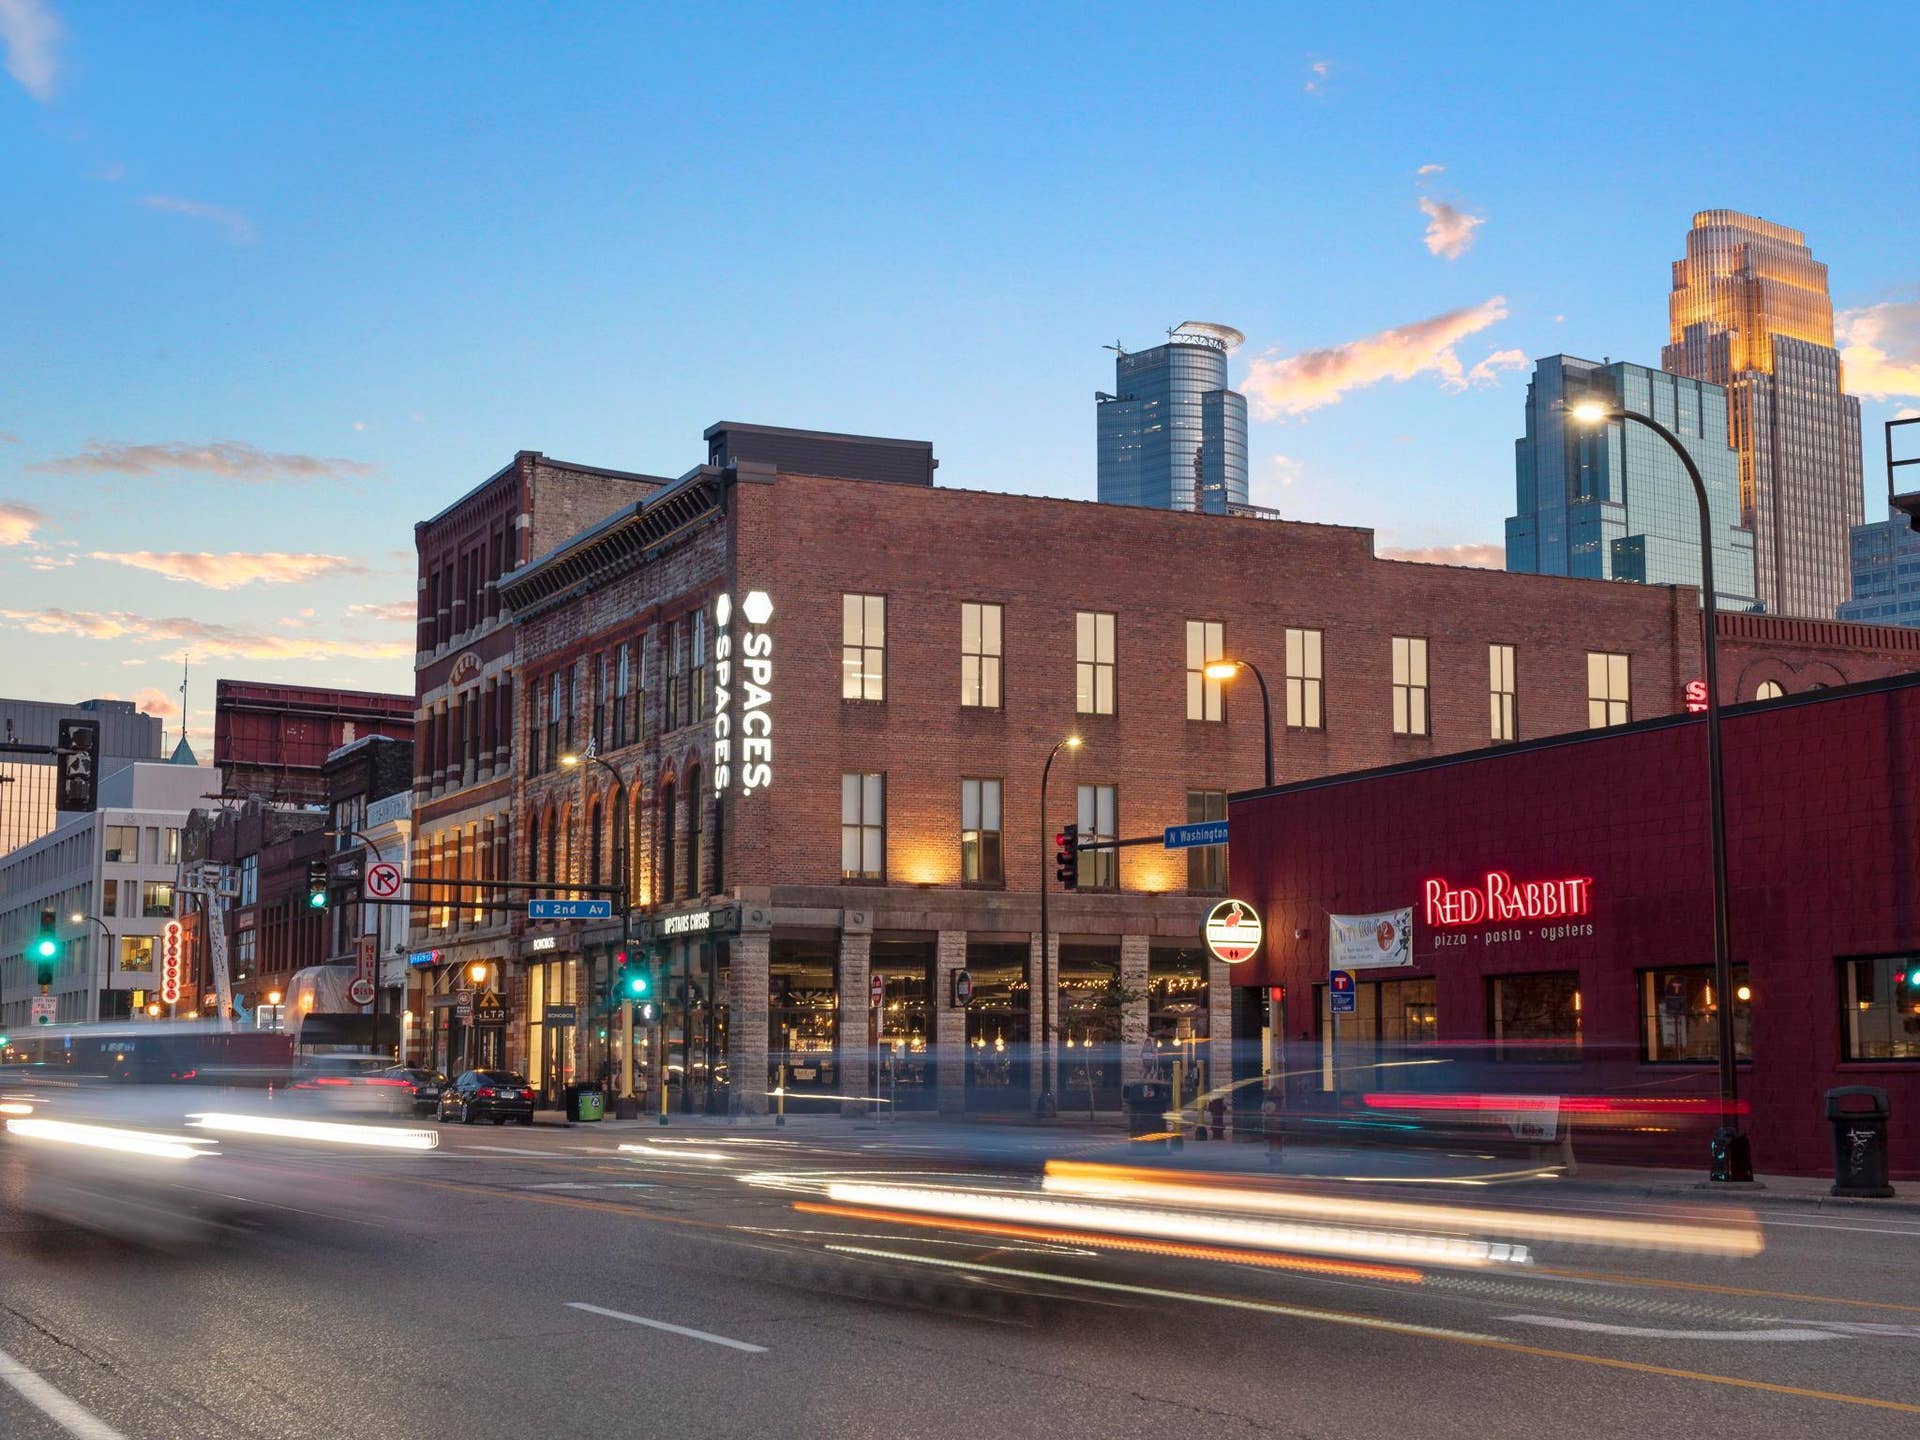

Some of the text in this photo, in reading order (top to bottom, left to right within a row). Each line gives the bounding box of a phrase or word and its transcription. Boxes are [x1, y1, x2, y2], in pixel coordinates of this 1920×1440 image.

[715, 634, 731, 799] SPACES.
[742, 631, 772, 797] SPACES.
[1169, 827, 1229, 843] N Washington
[535, 904, 604, 914] N 2nd Av
[1426, 872, 1589, 925] RED RABBIT
[689, 911, 710, 931] CIRCUS
[1434, 922, 1593, 949] pizza pasta oysters
